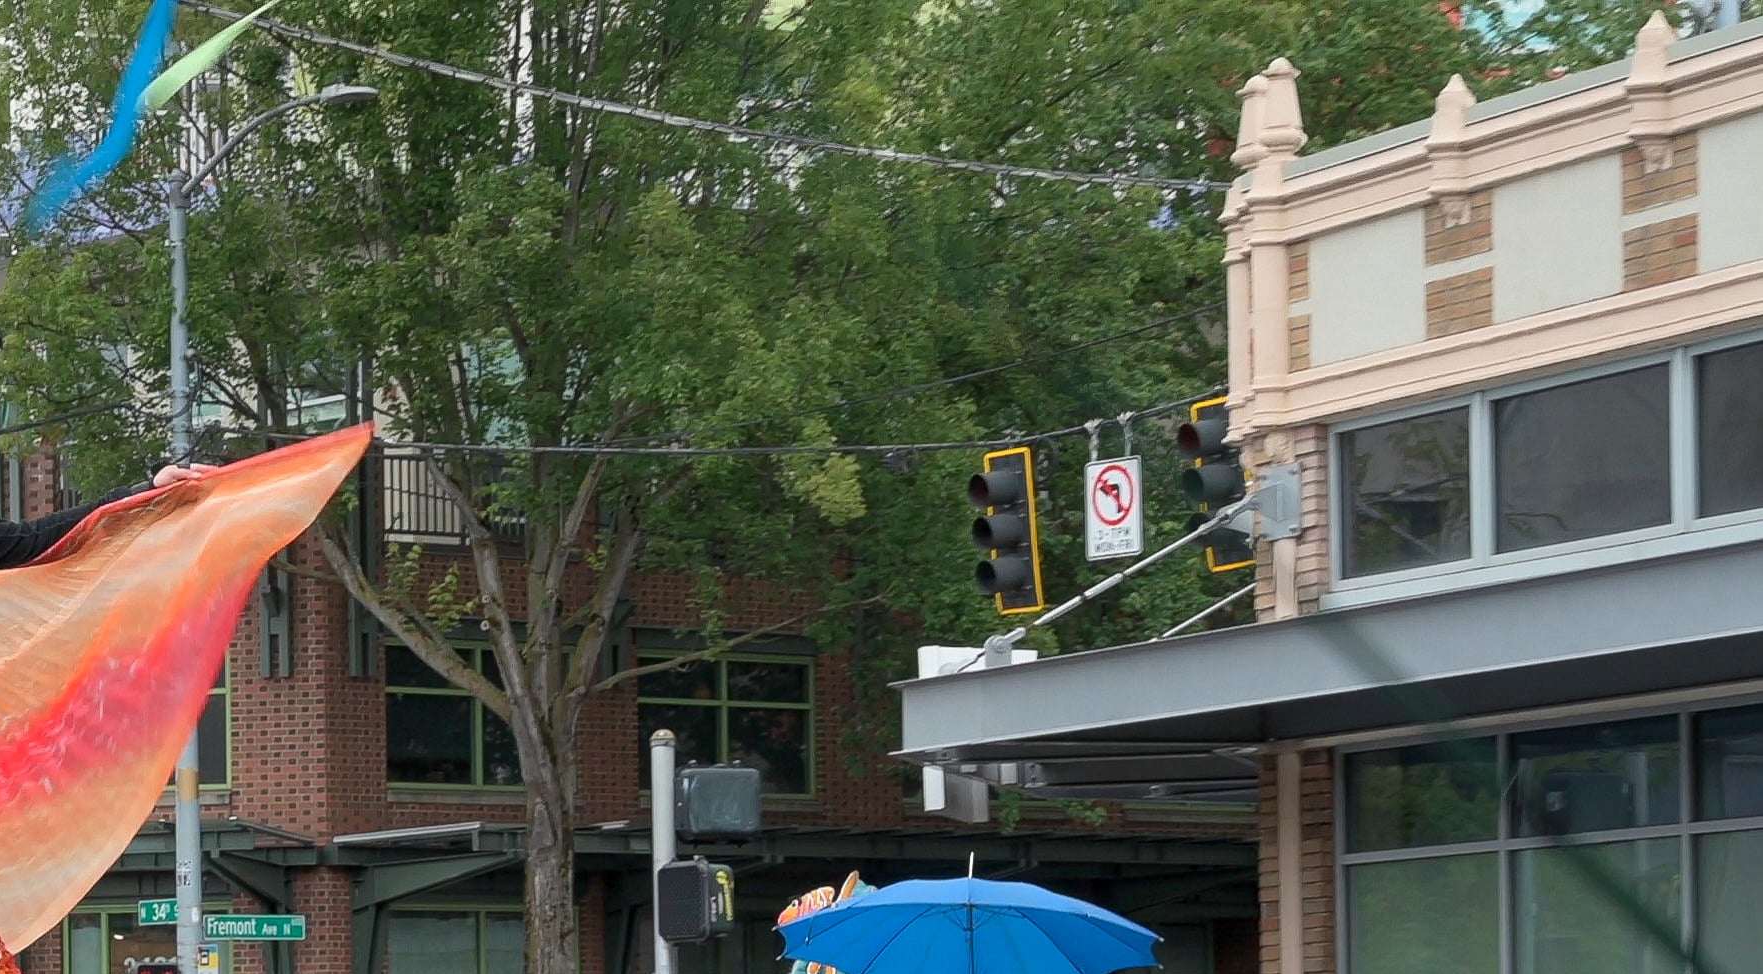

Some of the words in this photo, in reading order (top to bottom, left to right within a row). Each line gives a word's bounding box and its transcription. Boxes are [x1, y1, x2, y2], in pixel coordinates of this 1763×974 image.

[207, 917, 256, 935] Fremont
[262, 923, 277, 936] Ave
[283, 924, 291, 935] N
